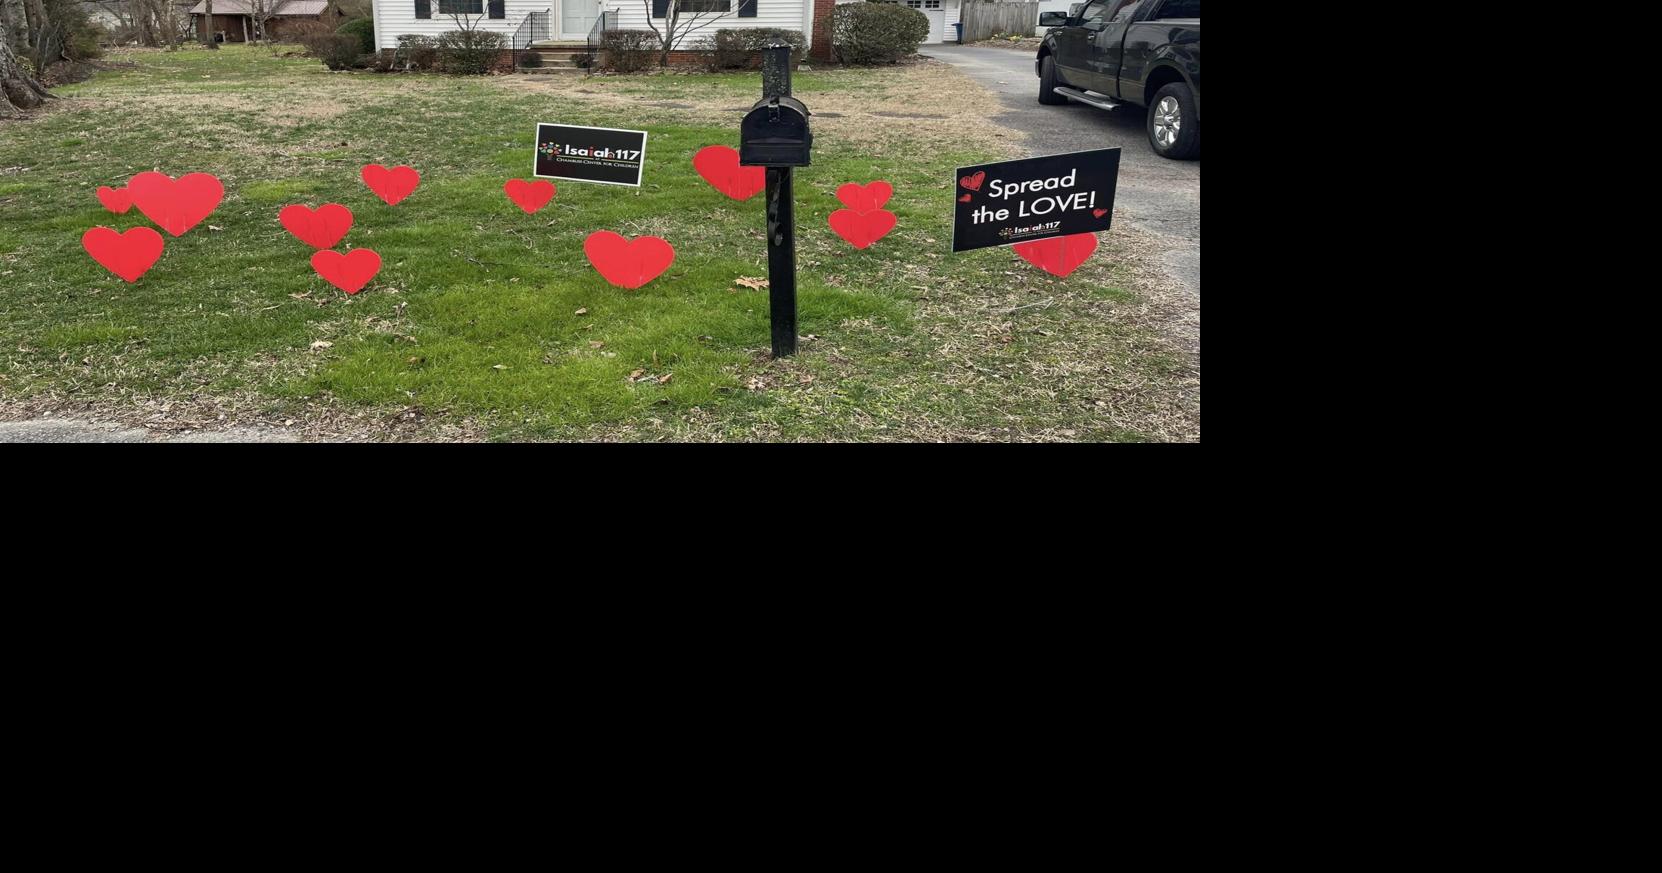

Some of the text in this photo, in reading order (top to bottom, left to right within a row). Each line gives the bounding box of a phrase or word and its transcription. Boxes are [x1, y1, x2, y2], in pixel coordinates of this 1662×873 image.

[988, 168, 1077, 200] Spread
[971, 191, 1096, 225] the LOVE!
